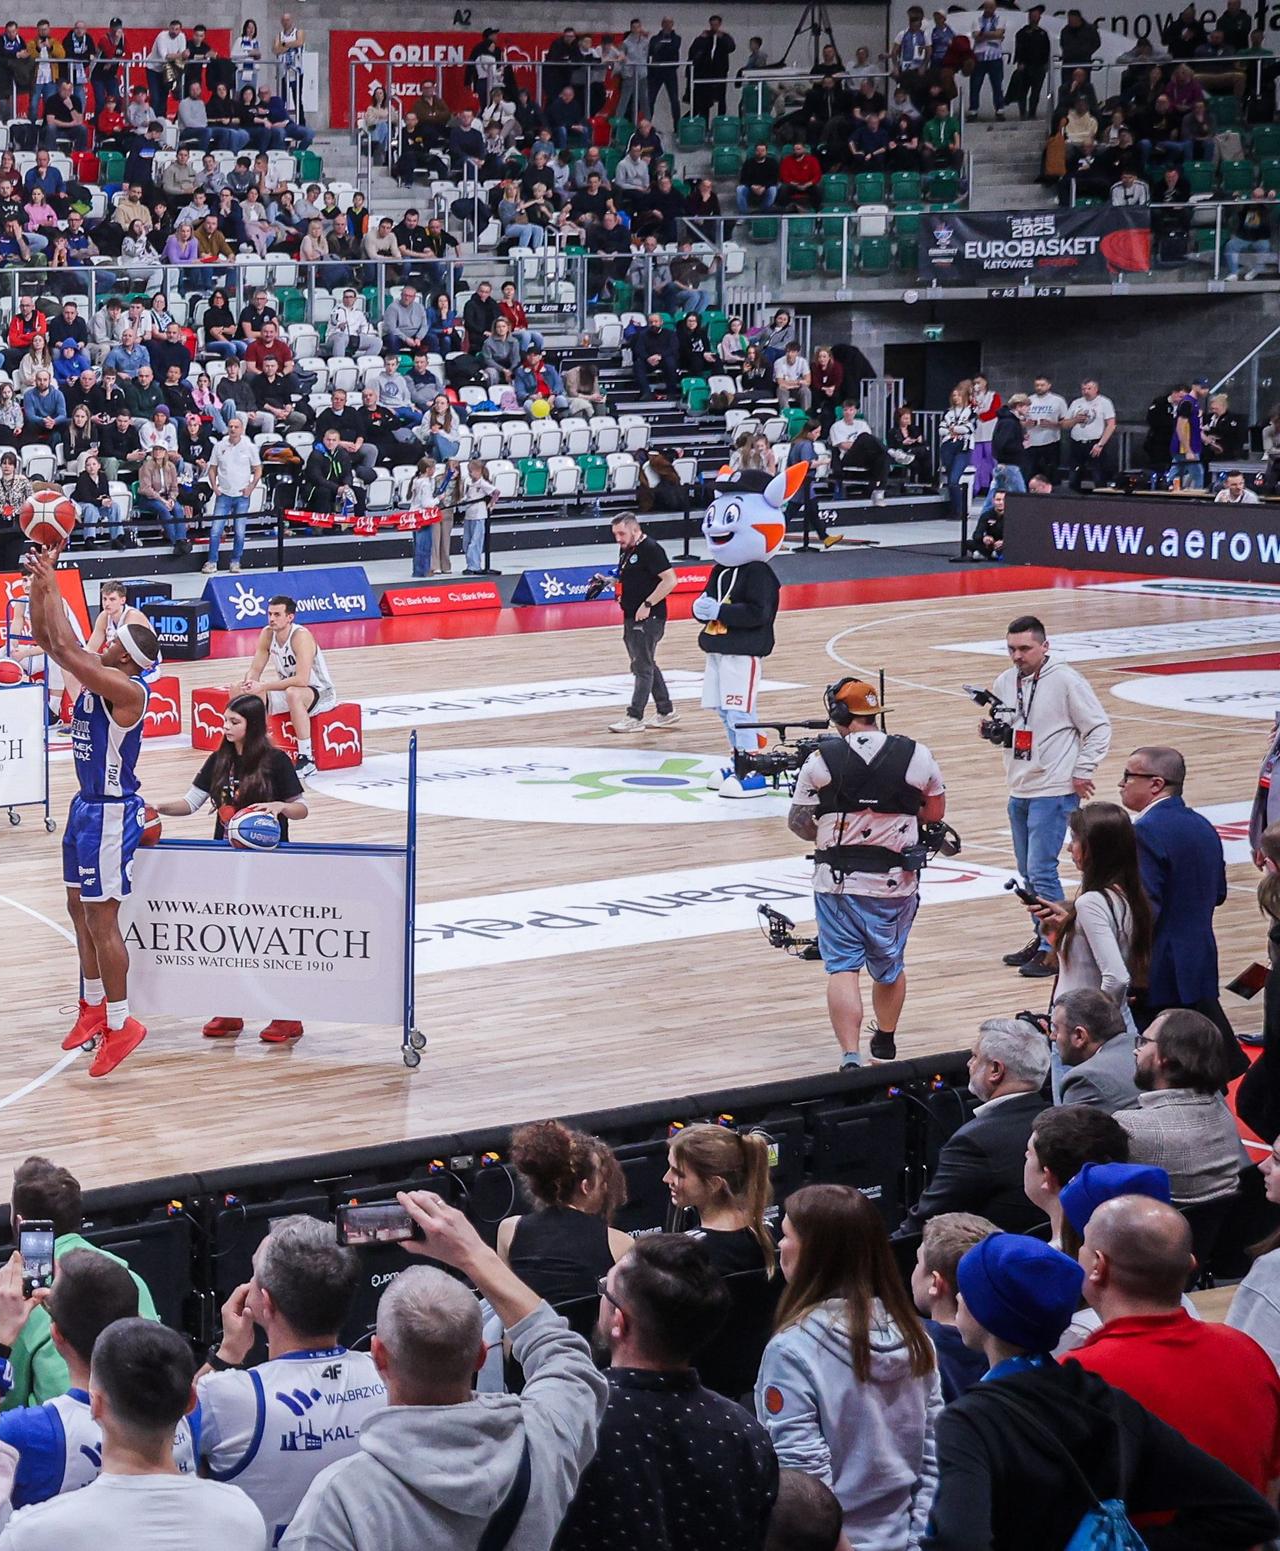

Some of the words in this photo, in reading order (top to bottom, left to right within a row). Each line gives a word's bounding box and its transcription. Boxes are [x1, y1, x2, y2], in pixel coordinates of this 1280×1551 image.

[452, 9, 472, 26] A2
[389, 44, 465, 68] ORLEN
[1011, 224, 1056, 238] 2025
[964, 236, 1101, 259] EUROBASKET
[983, 259, 1034, 270] KATOWICE
[1002, 290, 1014, 298] A2
[1037, 289, 1050, 297] A3
[333, 593, 365, 612] łączy
[157, 633, 189, 642] ATION
[726, 694, 744, 706] 25
[566, 882, 812, 918] Bank
[147, 899, 343, 920] WWW.AEROWATCH.PL
[123, 920, 371, 959] AEROWATCH
[155, 954, 195, 966] SWISS
[199, 956, 260, 969] WATCHES
[262, 958, 302, 971] SINCE
[306, 960, 334, 972] 1910
[321, 1364, 343, 1381] 4F
[324, 1384, 388, 1406] WAŁBRZYCH
